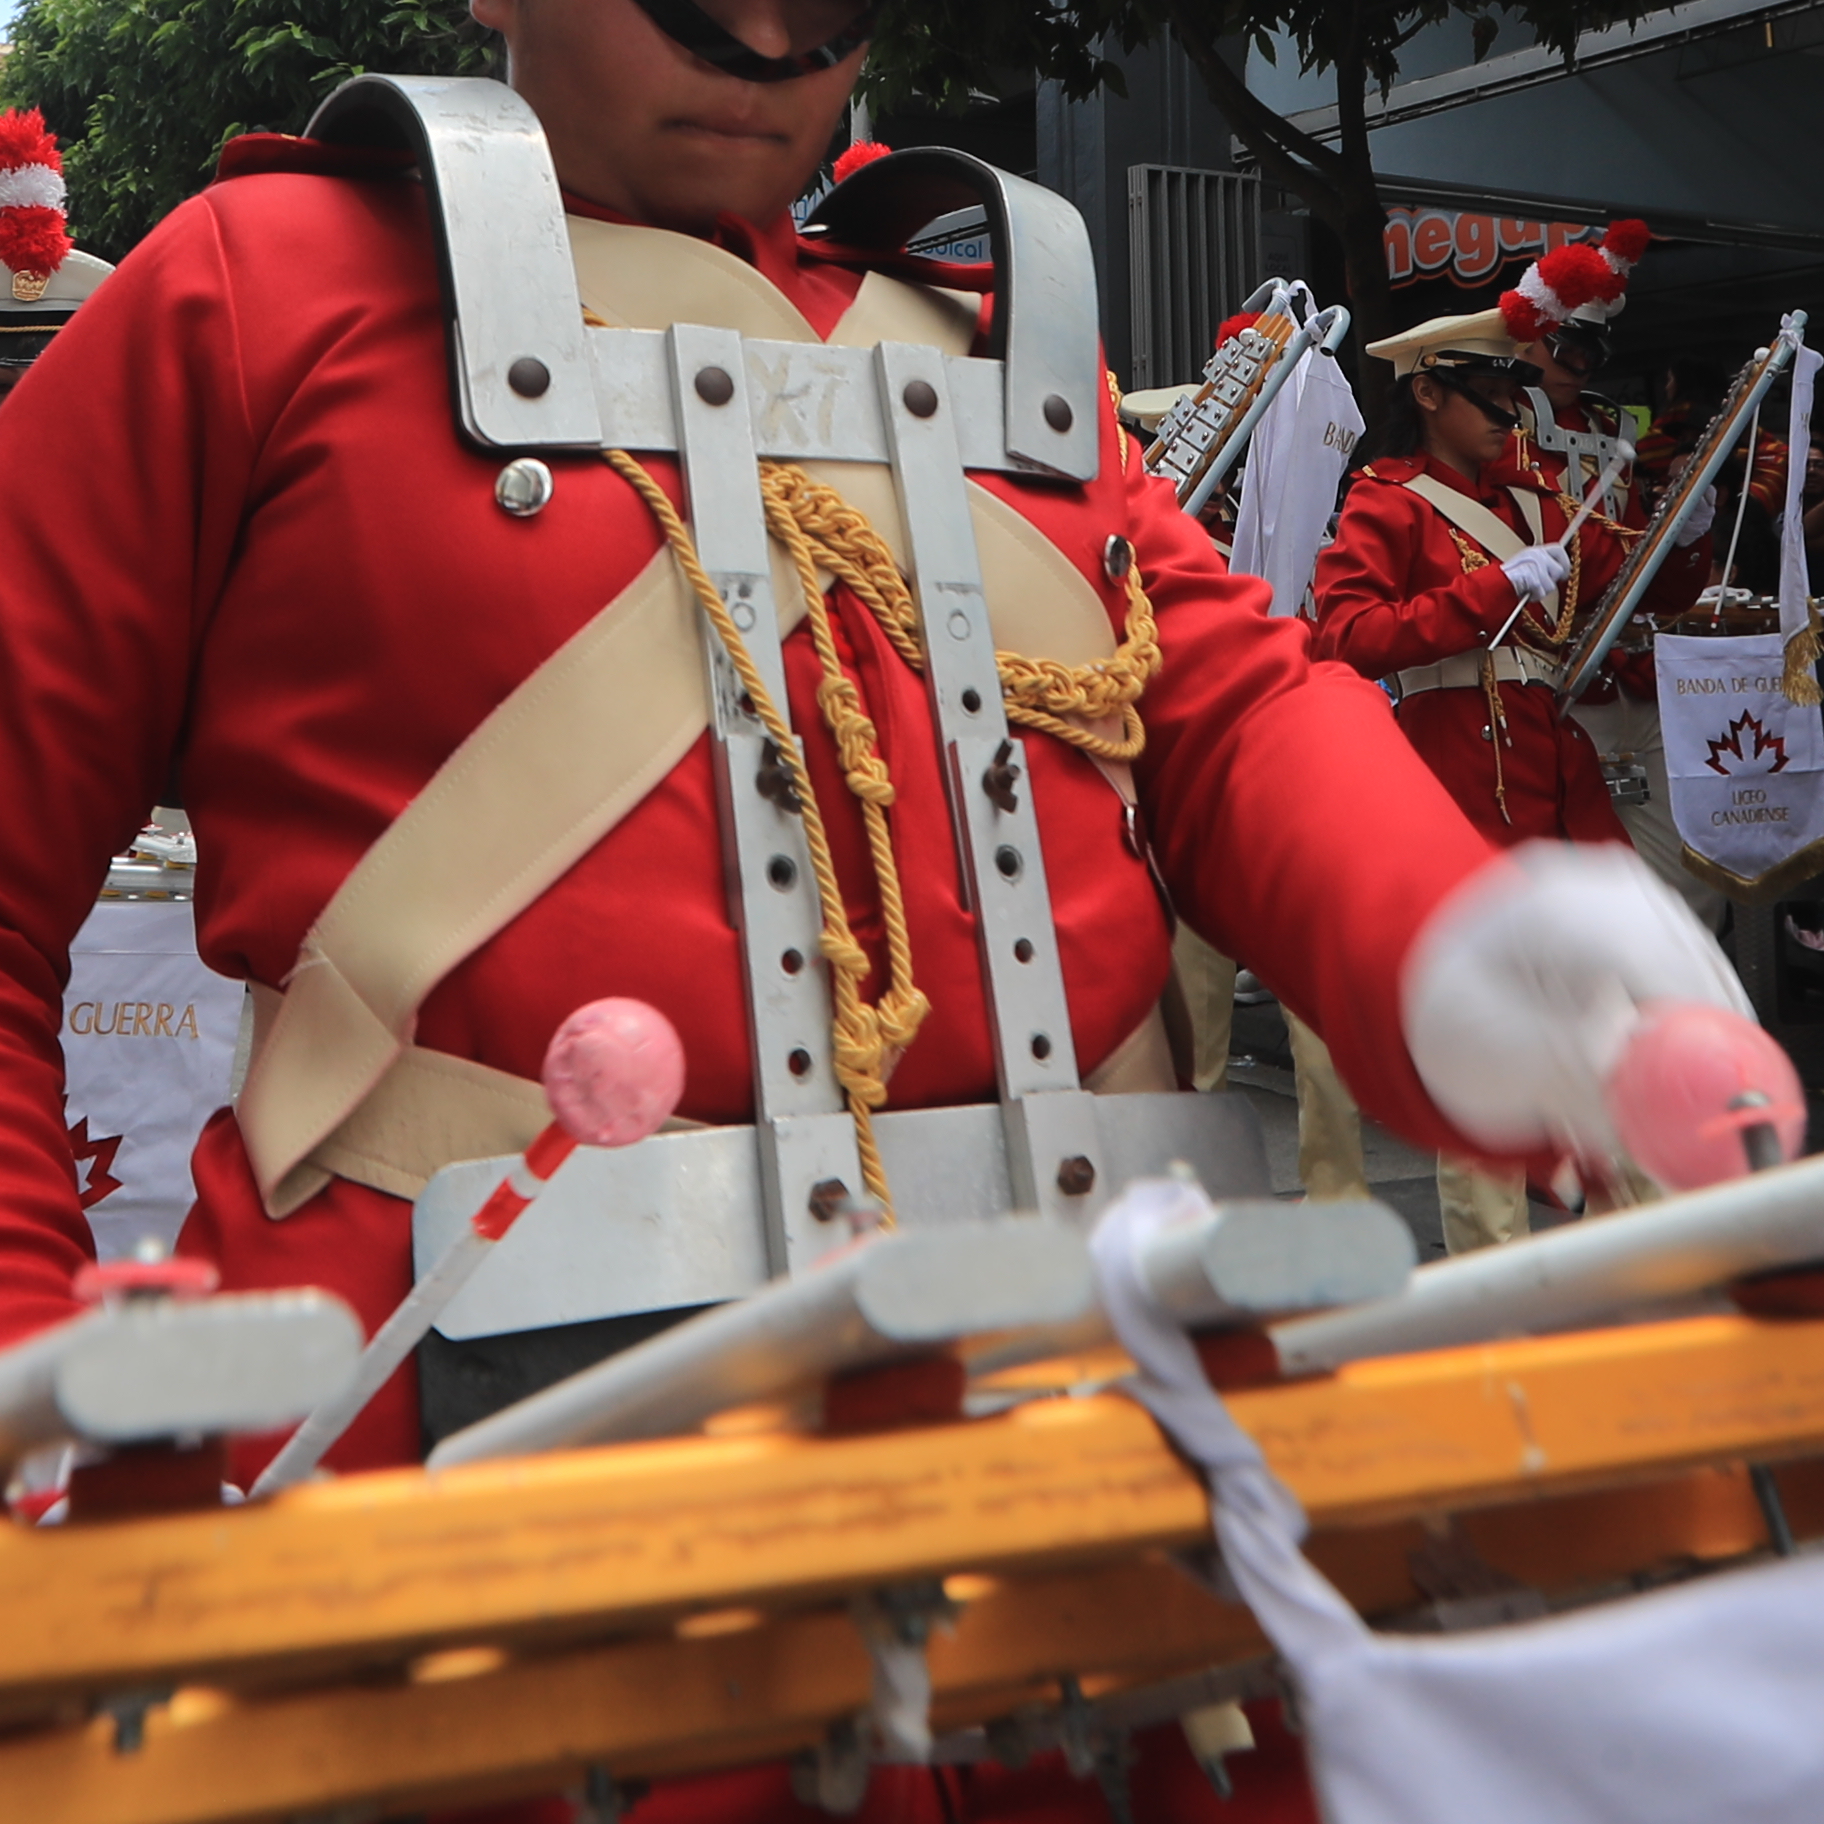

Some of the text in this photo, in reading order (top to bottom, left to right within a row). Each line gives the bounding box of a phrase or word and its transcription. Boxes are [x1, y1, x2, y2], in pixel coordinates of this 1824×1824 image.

[1677, 678, 1727, 695] BANDA
[1732, 677, 1749, 693] DE
[1732, 789, 1767, 805] LICEO
[1711, 807, 1790, 826] CANADIENSE
[69, 1001, 199, 1039] GUERRA
